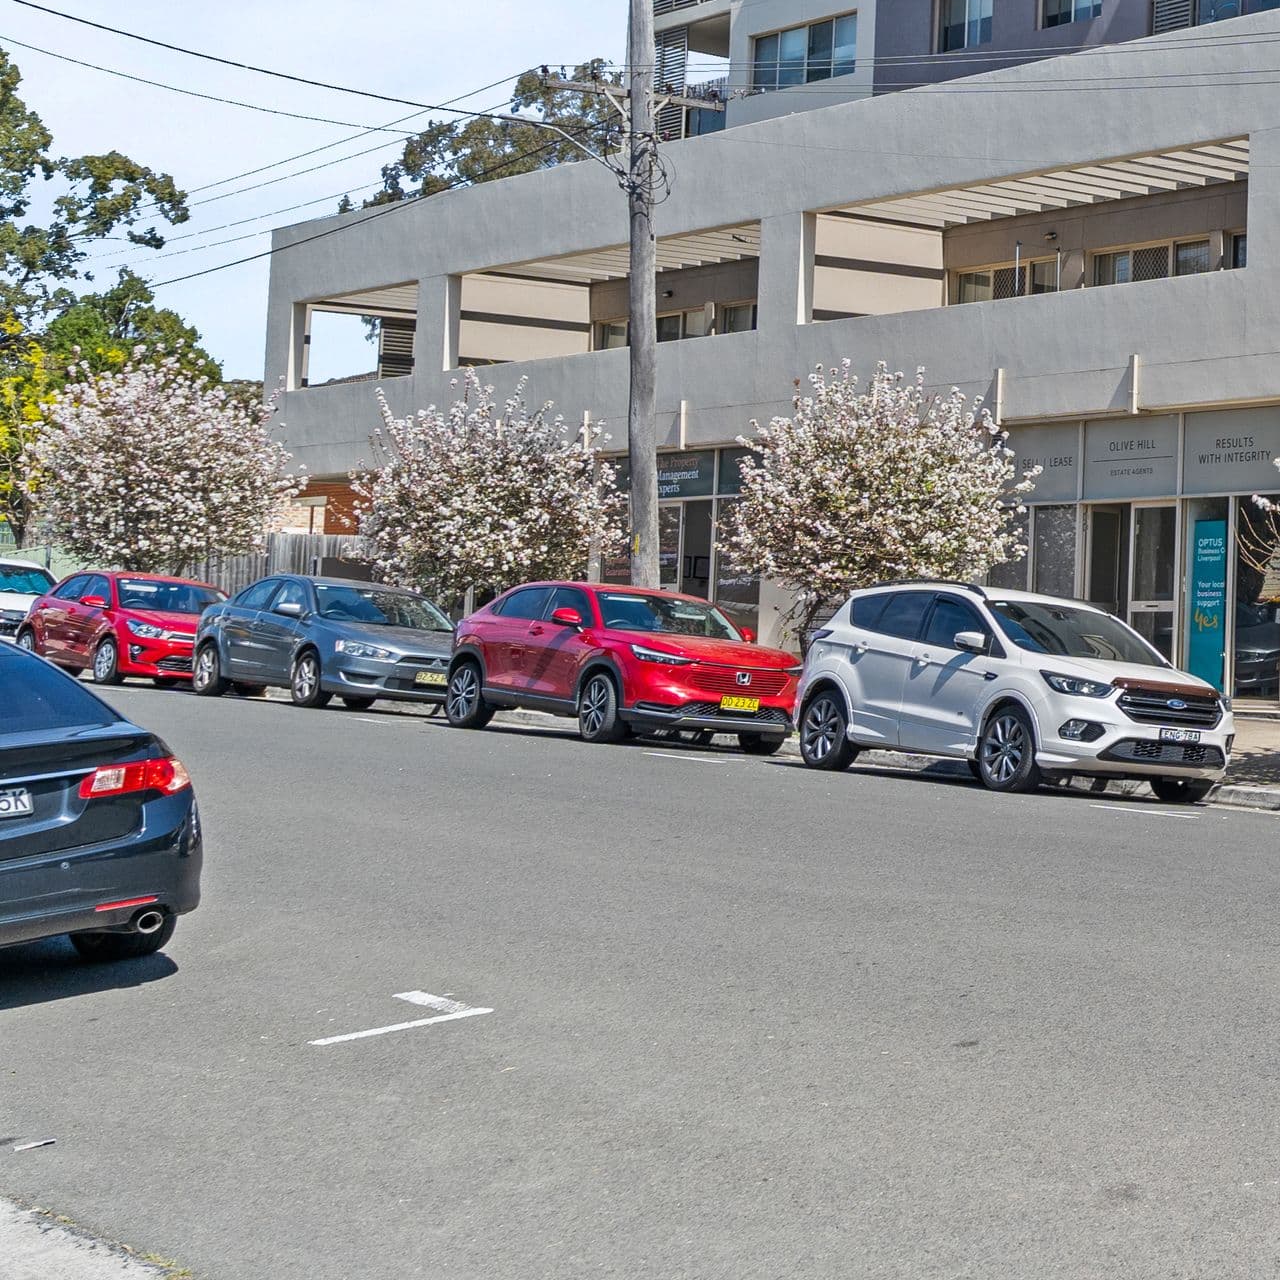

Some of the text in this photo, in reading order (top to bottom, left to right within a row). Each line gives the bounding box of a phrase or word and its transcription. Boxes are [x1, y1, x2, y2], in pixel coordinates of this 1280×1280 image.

[1109, 439, 1156, 451] OLIVE HILL
[1215, 436, 1254, 448] RESULTS
[1049, 456, 1073, 468] LEASE
[1198, 450, 1271, 464] WITH INTEGRITY
[657, 469, 699, 483] anagement
[658, 484, 680, 497] xperts
[1198, 537, 1223, 547] OPTUS
[1197, 580, 1212, 588] Your
